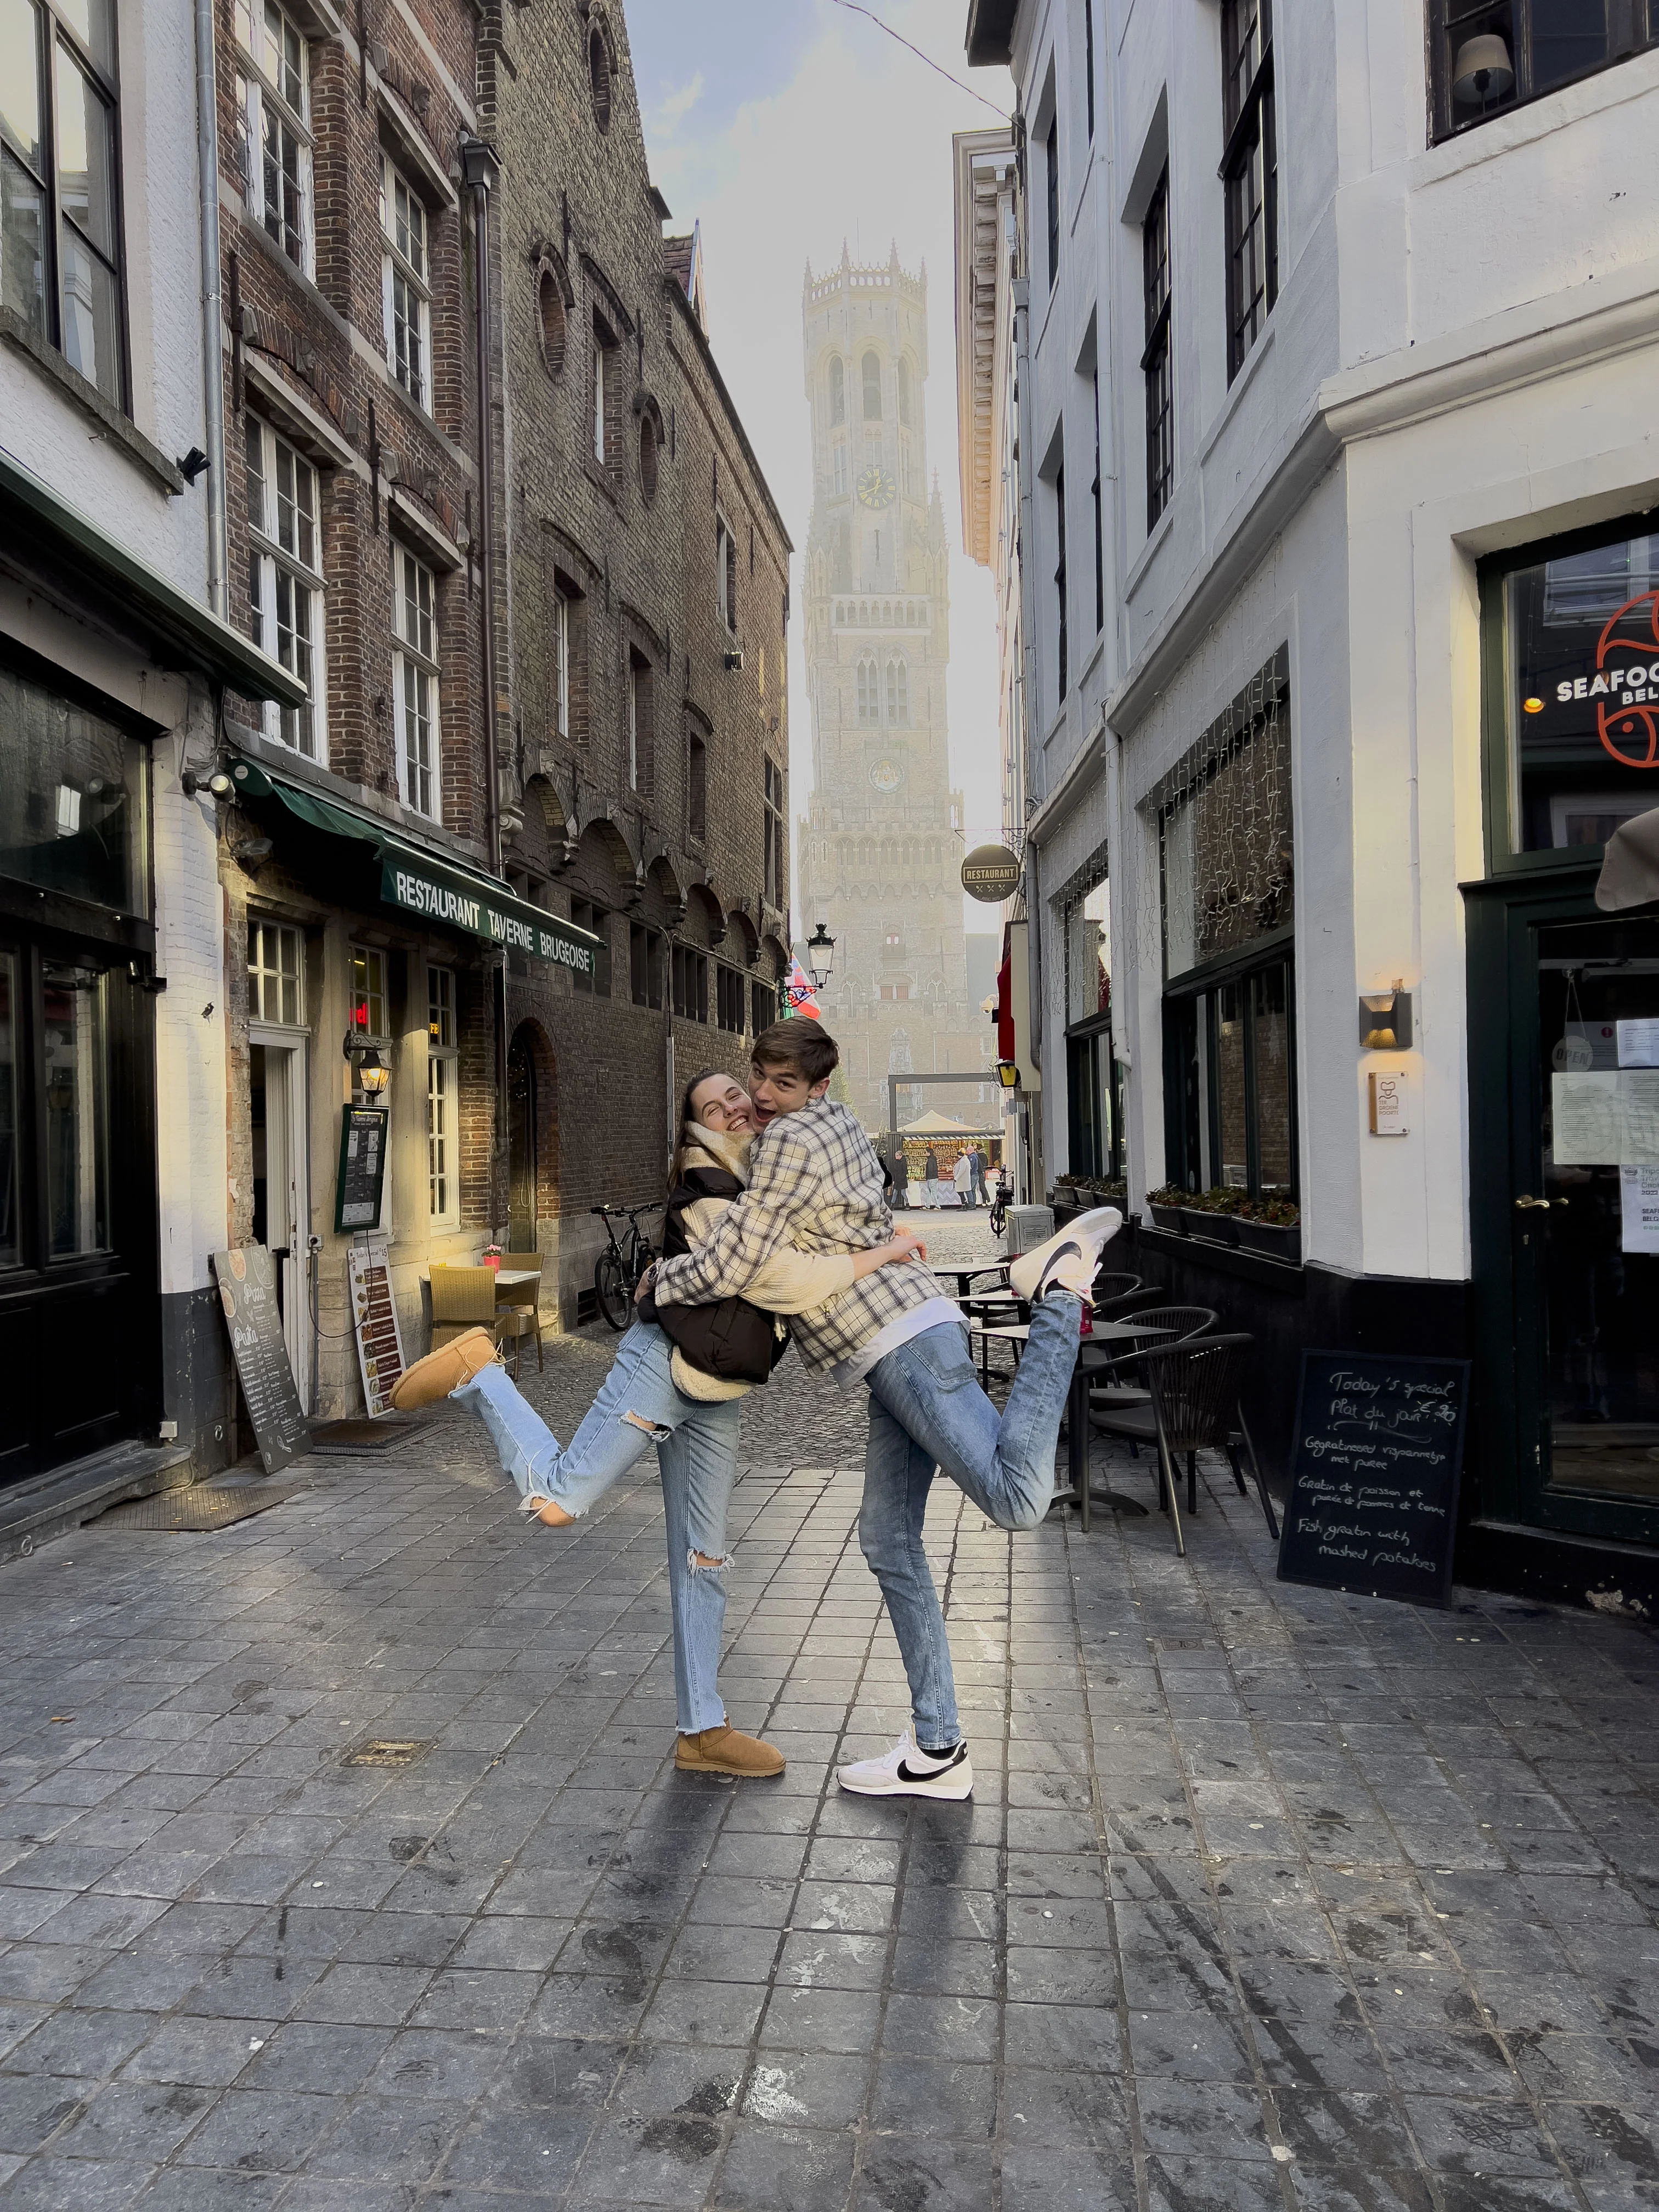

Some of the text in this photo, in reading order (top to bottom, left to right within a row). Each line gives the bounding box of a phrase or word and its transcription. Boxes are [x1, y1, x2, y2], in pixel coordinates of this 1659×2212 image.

[1622, 687, 1658, 705] BEL
[967, 868, 1014, 879] RESTAURANT
[397, 871, 589, 972] RESTAURANT TAVERNE BRUGEOISE
[1556, 1048, 1589, 1067] OPEN
[244, 1283, 266, 1304] Pizza
[234, 1324, 258, 1349] Pasta
[1329, 1372, 1455, 1398] Today's special
[1330, 1398, 1357, 1419] Plat
[1364, 1406, 1386, 1418] du
[1331, 1455, 1350, 1464] met
[1299, 1476, 1424, 1499] Gratin de poisson et
[1400, 1501, 1411, 1510] de
[1297, 1519, 1410, 1546] Fish gratin with
[1319, 1544, 1436, 1572] mashed potatoes
